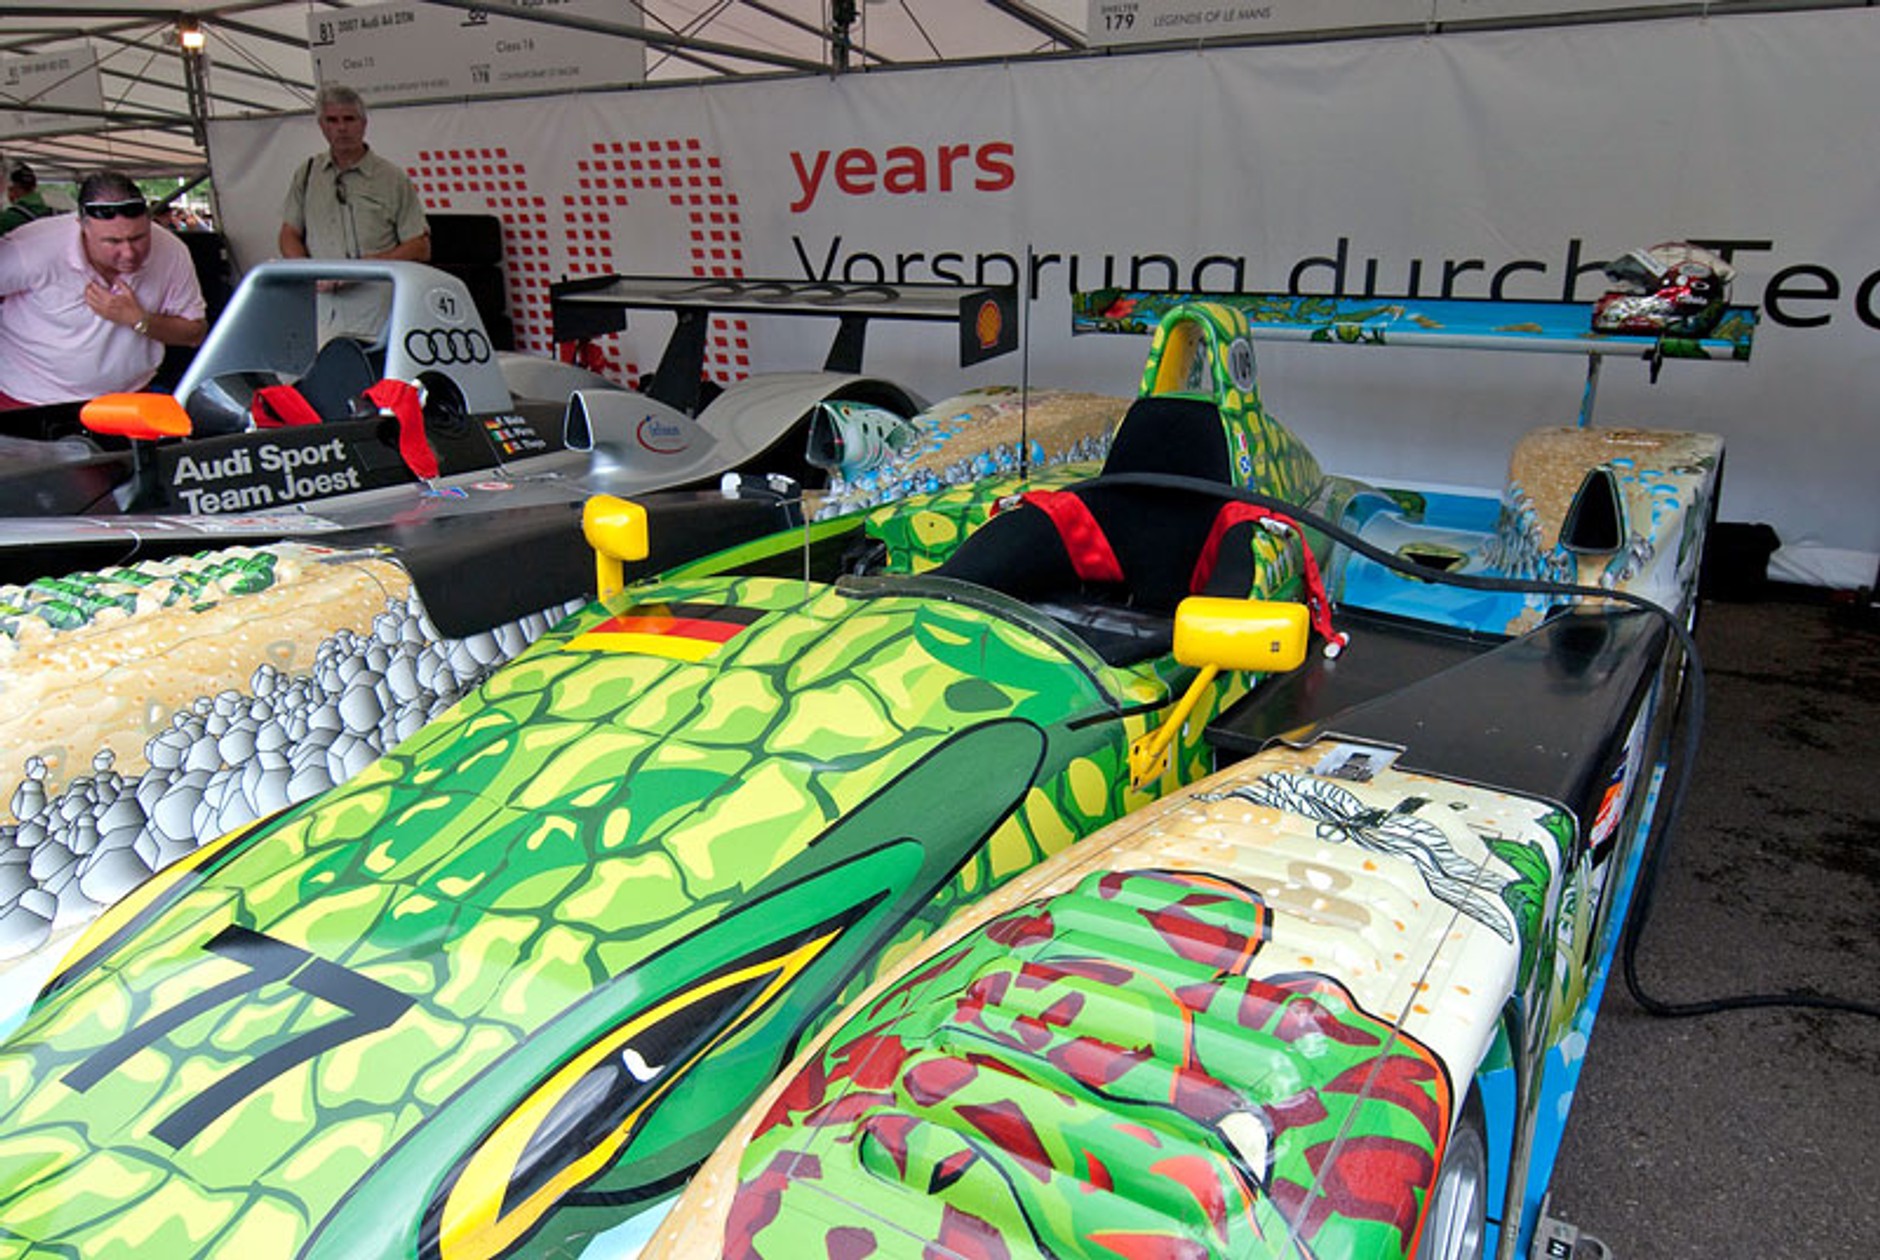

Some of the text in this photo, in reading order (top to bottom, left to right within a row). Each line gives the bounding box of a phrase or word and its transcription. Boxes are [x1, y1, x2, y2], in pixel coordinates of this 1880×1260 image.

[361, 16, 379, 29] Audi
[1105, 13, 1135, 31] 179
[1154, 7, 1272, 28] LEGENDS OF LE MANS
[496, 40, 521, 53] Class
[789, 141, 1016, 213] years
[172, 438, 347, 485] Audi Sport
[178, 467, 361, 516] Team Joest
[60, 923, 418, 1151] 77
